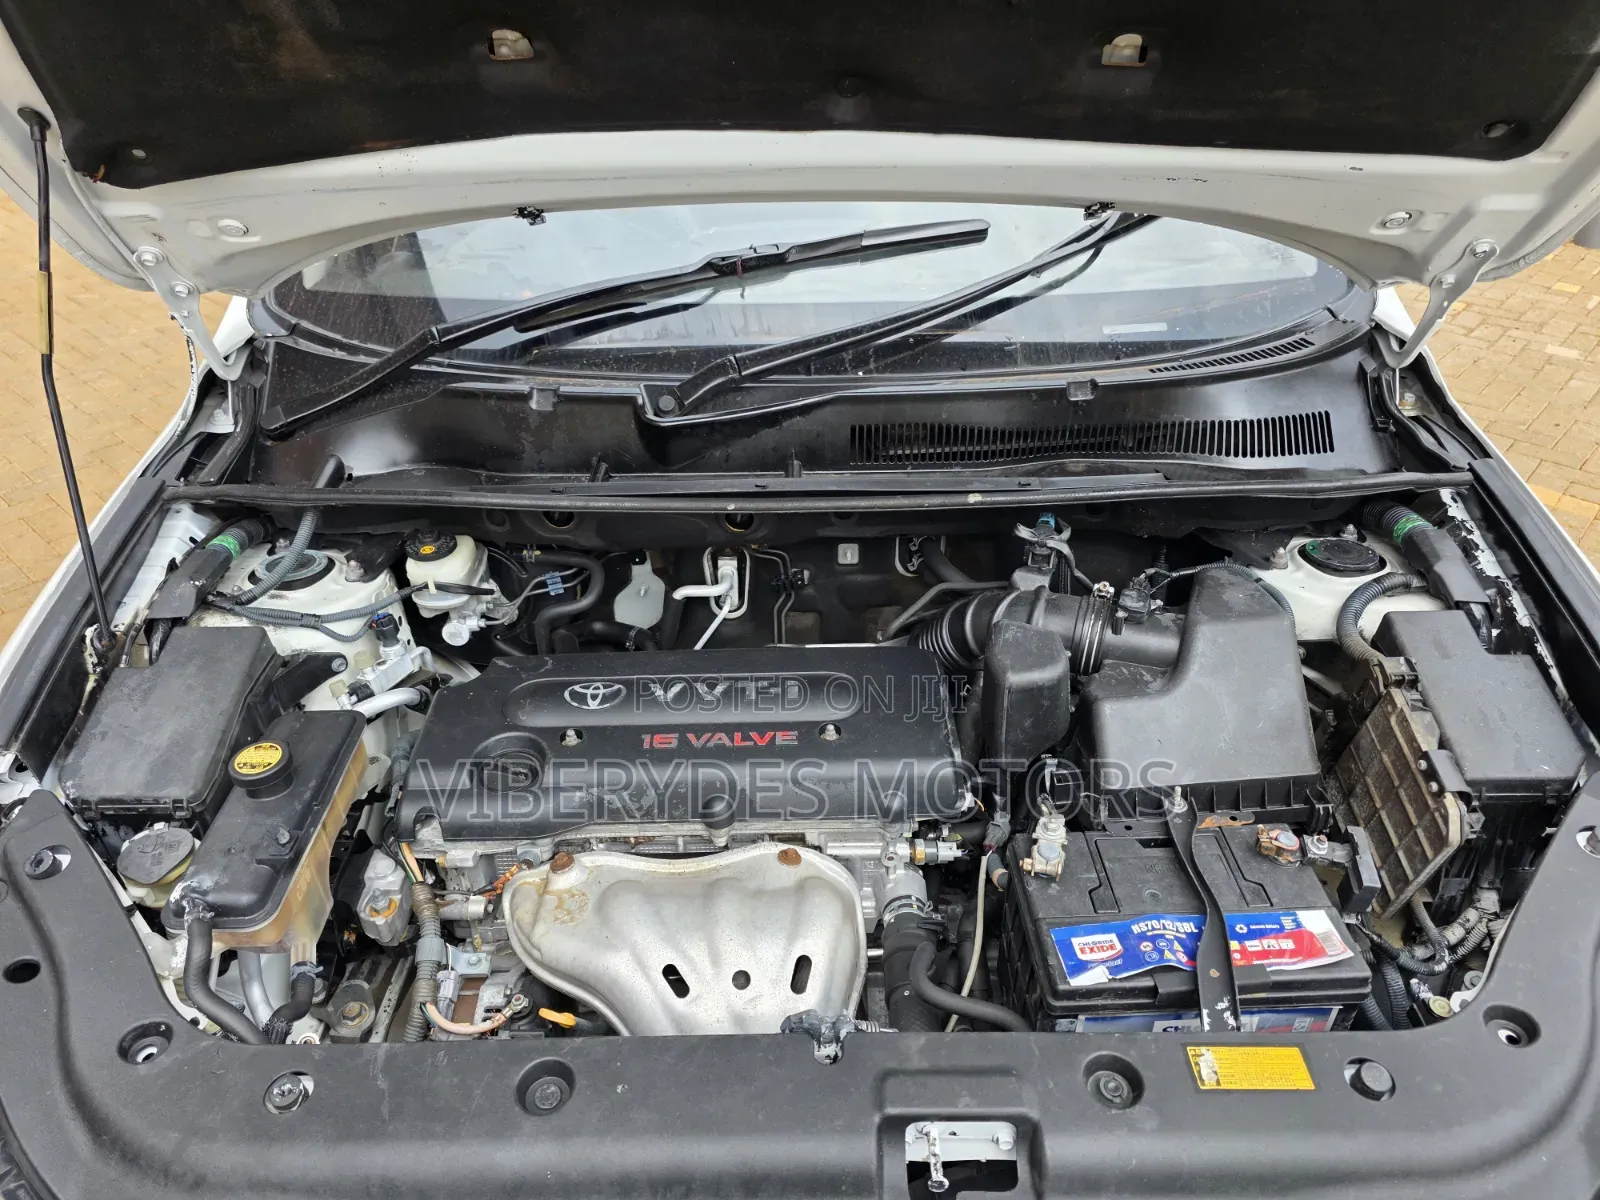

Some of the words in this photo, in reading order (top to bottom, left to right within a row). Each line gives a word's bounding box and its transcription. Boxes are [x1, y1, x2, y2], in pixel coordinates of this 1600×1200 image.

[642, 733, 679, 749] 16
[686, 730, 799, 748] VALVE
[1077, 939, 1115, 948] CHLORIDE
[1079, 943, 1118, 955] EXIDE
